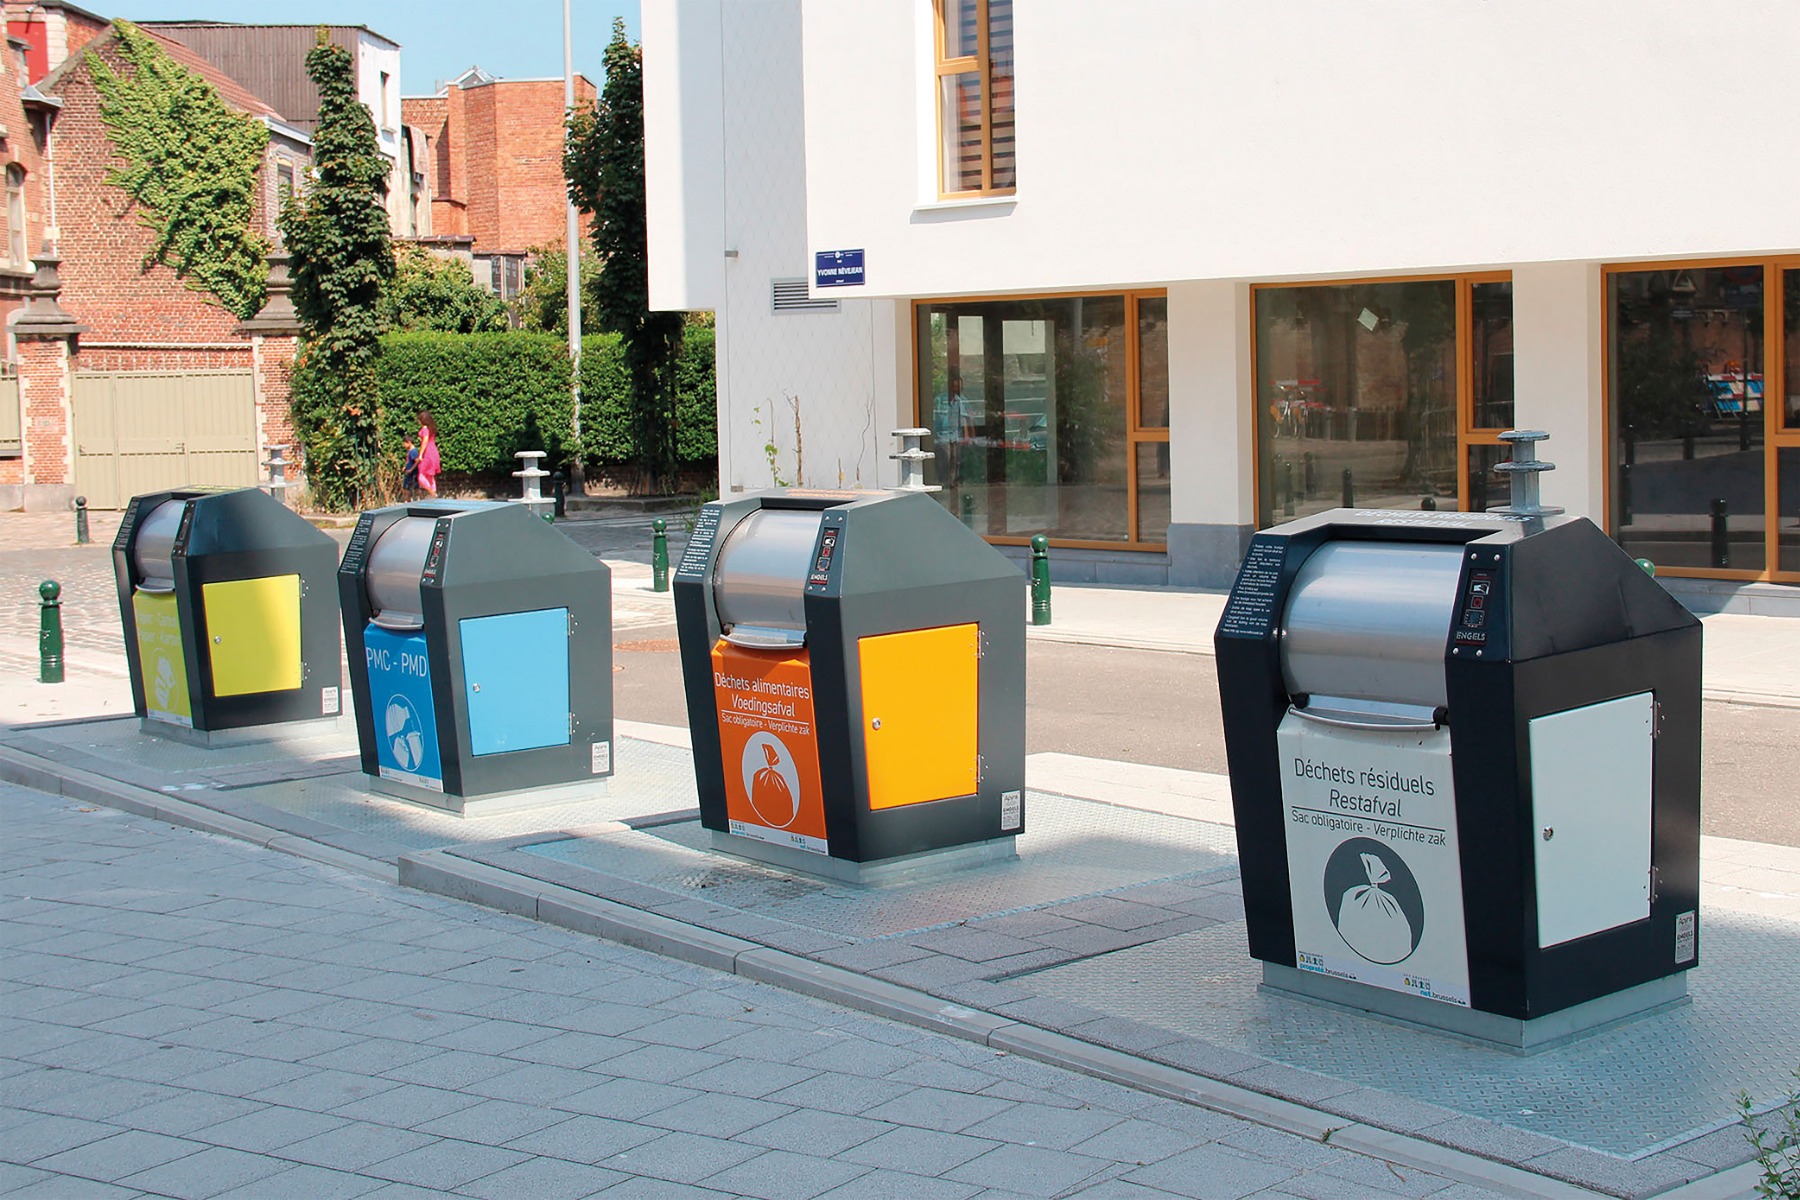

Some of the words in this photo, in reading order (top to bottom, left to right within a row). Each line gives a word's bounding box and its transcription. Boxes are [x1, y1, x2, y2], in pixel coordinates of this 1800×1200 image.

[1456, 631, 1486, 641] ENGELS
[365, 646, 391, 671] PMC
[401, 652, 427, 677] PMD
[714, 672, 750, 691] Déchets
[752, 677, 810, 699] alimentaires
[731, 693, 795, 717] Voedingsafval
[721, 712, 733, 723] Sac
[733, 715, 763, 728] obligatoire
[768, 720, 798, 733] Verplichte
[799, 726, 810, 735] zak
[1294, 757, 1355, 785] Déchets
[1360, 767, 1435, 796] résiduels
[1329, 788, 1402, 817] Restafval
[1291, 809, 1309, 823] Sac
[1311, 814, 1363, 832] obligatoire
[1373, 823, 1425, 843] Verplichte
[1428, 833, 1446, 846] zak
